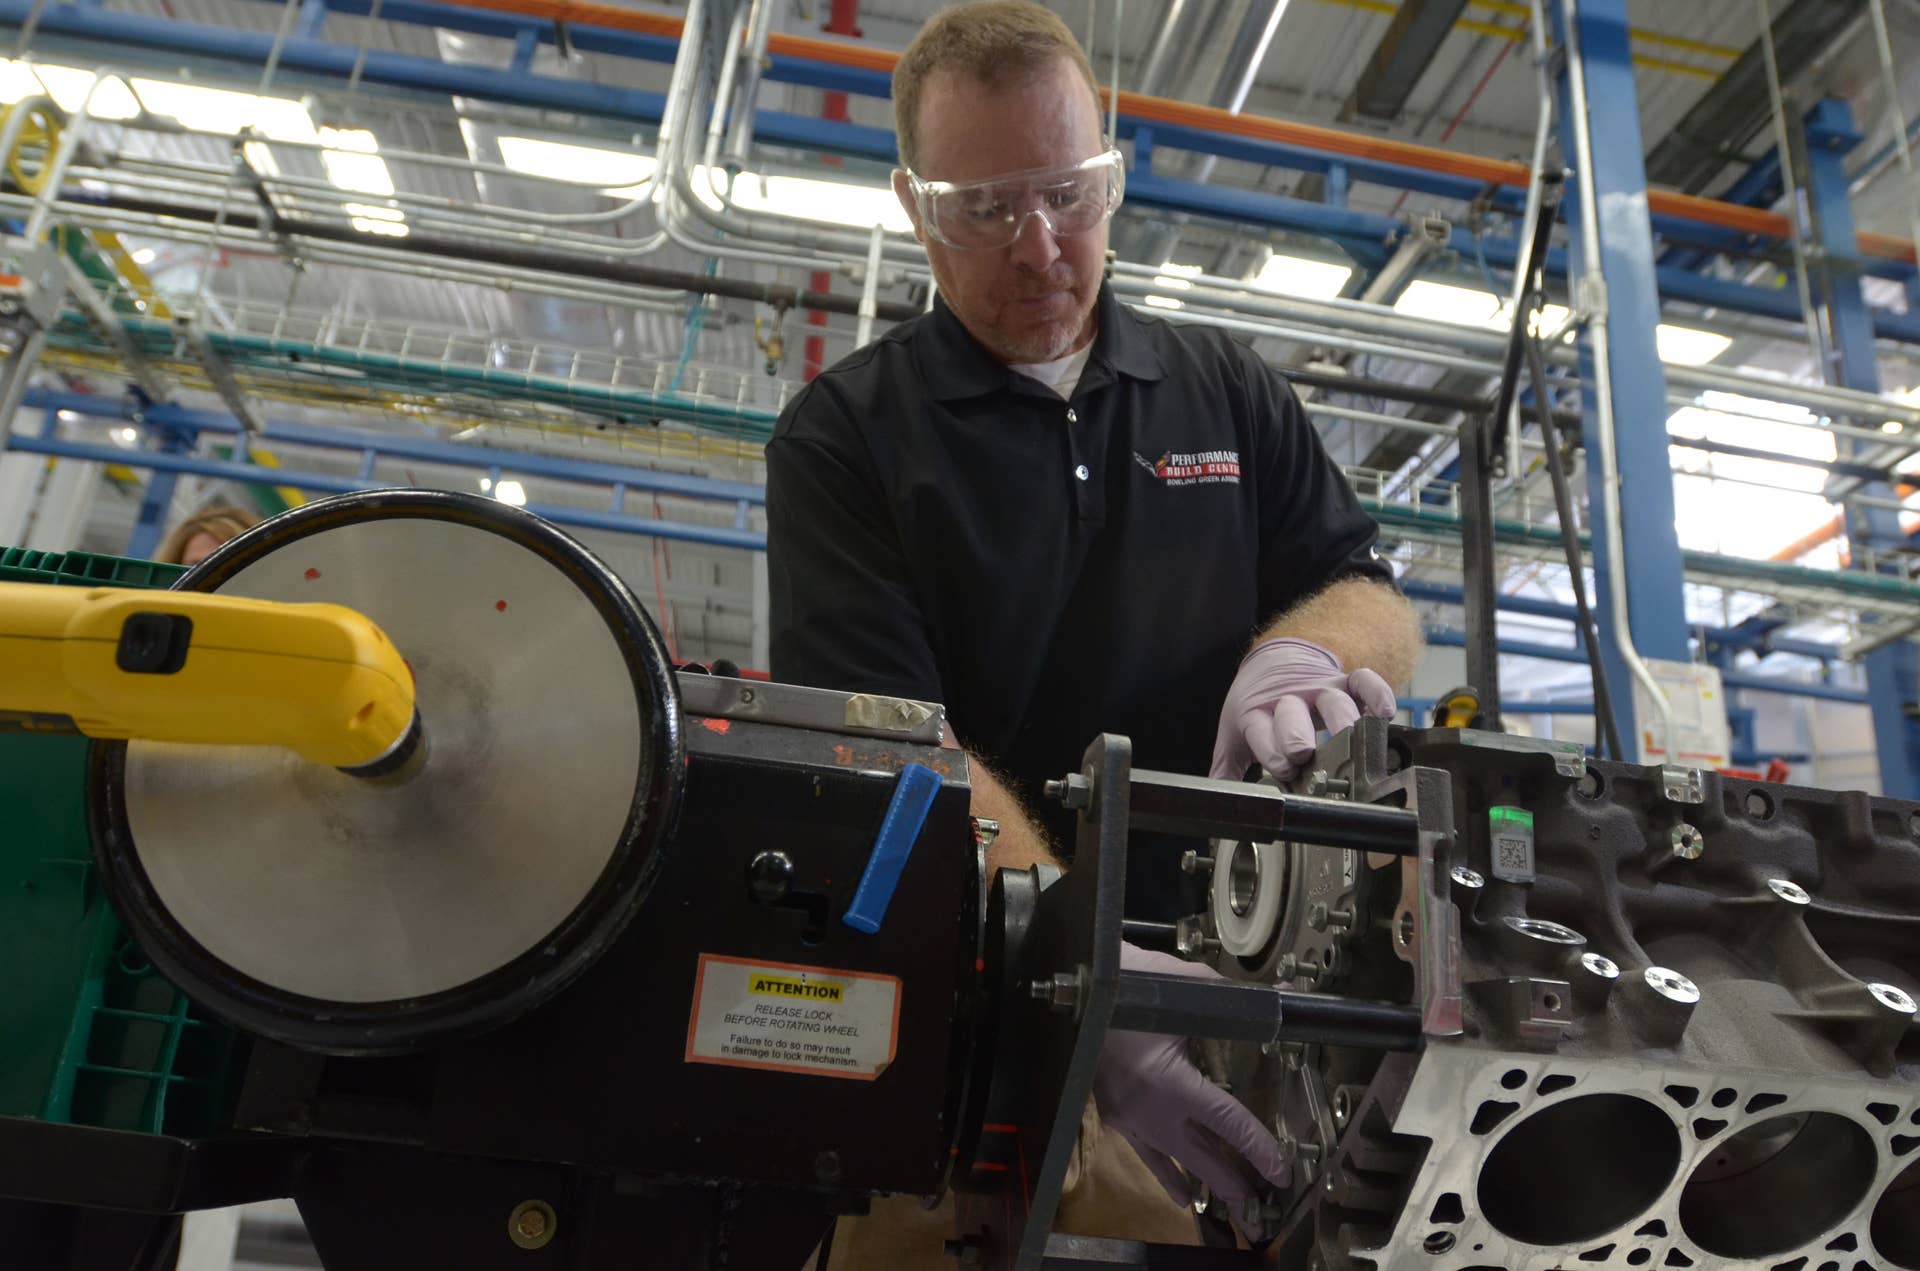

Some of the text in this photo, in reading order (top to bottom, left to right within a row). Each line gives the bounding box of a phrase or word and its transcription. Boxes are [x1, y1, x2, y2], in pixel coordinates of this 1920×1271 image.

[1167, 465, 1202, 477] BUILD
[1167, 477, 1196, 486] BOWLING
[1198, 475, 1220, 484] GREEN
[755, 980, 840, 999] ATTENTION
[754, 1004, 833, 1021] RELEASE LOCK
[724, 1013, 860, 1038] BEFORE ROTATING WHEEL
[730, 1033, 851, 1056] Failure to do so may result
[720, 1043, 859, 1067] in damage to lock mechanism.
